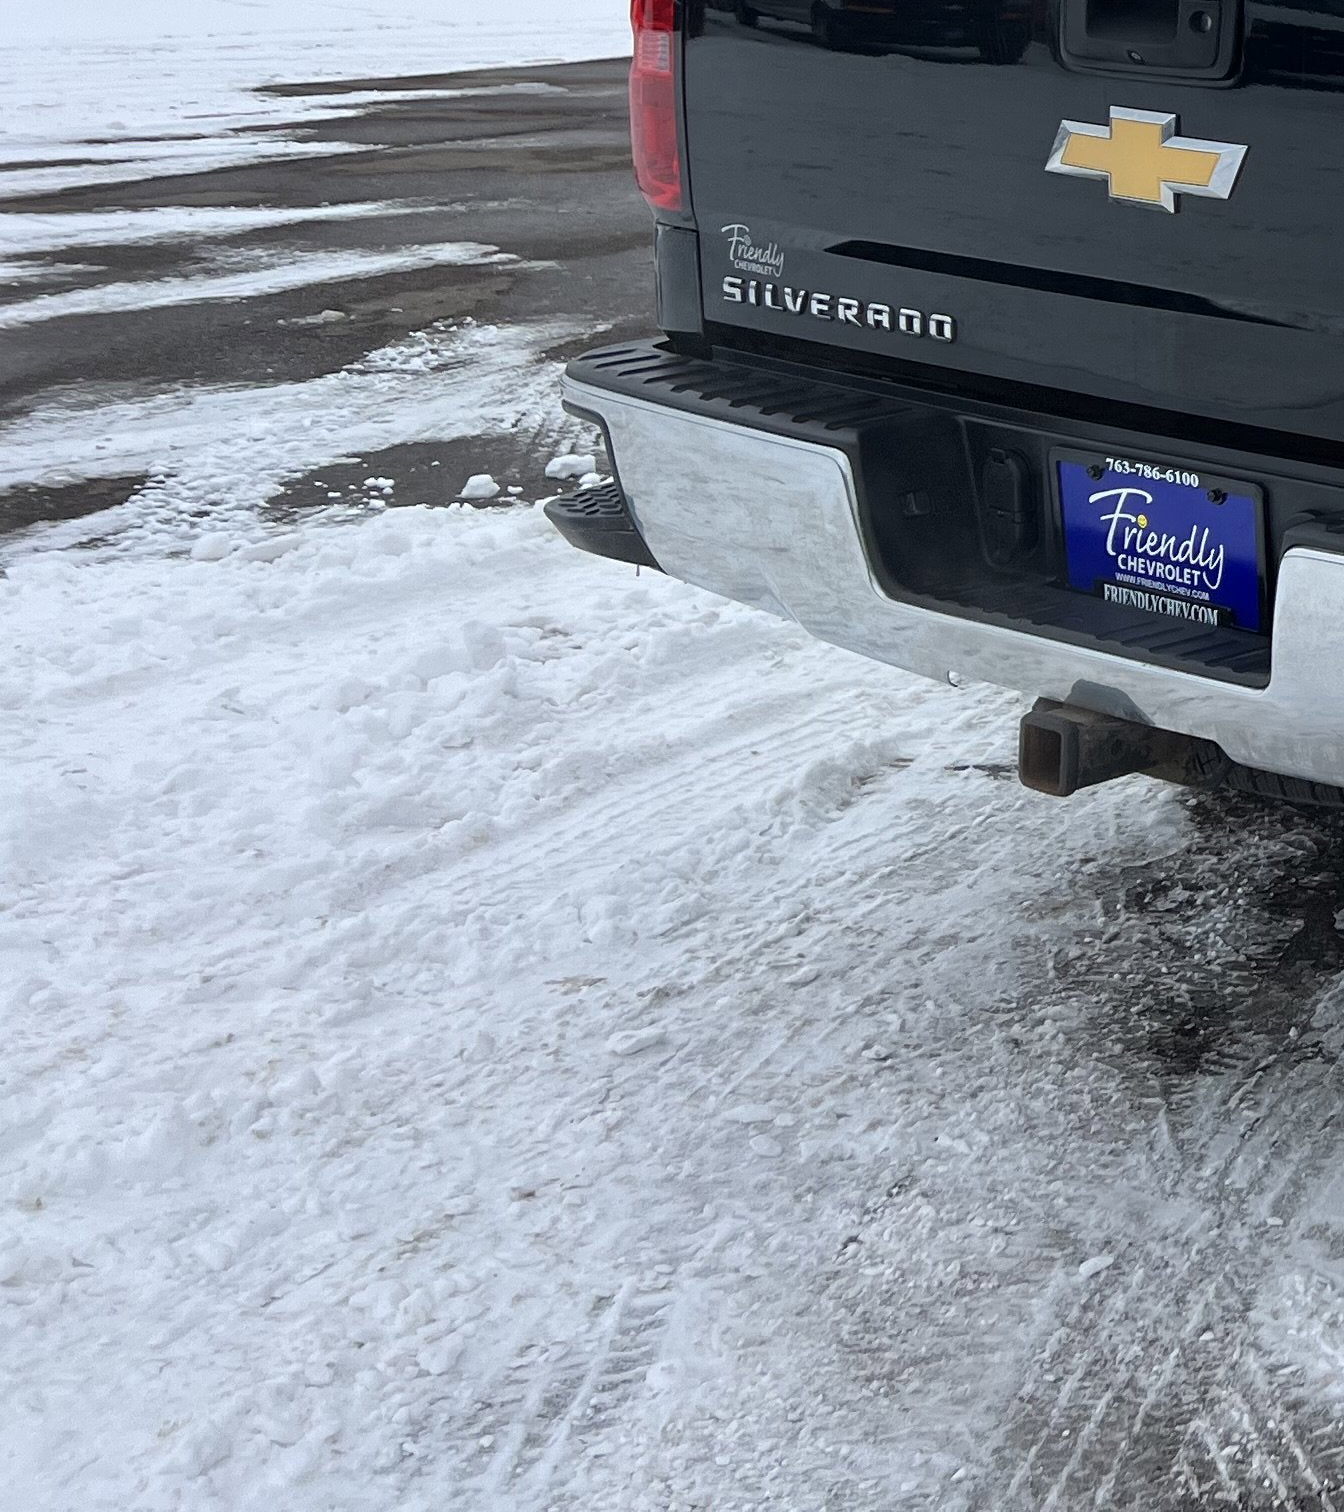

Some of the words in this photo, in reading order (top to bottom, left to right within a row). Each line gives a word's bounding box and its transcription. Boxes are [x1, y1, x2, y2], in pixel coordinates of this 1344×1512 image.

[721, 223, 784, 277] Friendly
[734, 259, 773, 275] CHEVROLET
[722, 275, 955, 343] SILVERADO
[1105, 457, 1200, 488] 763-786-6100
[1089, 487, 1224, 590] Friendly
[1115, 572, 1211, 601] WWW.FRIENDLYCHEV.COM
[1117, 553, 1201, 586] CHEVROLET
[1103, 583, 1219, 627] FRIENDLYCHEV.COM
